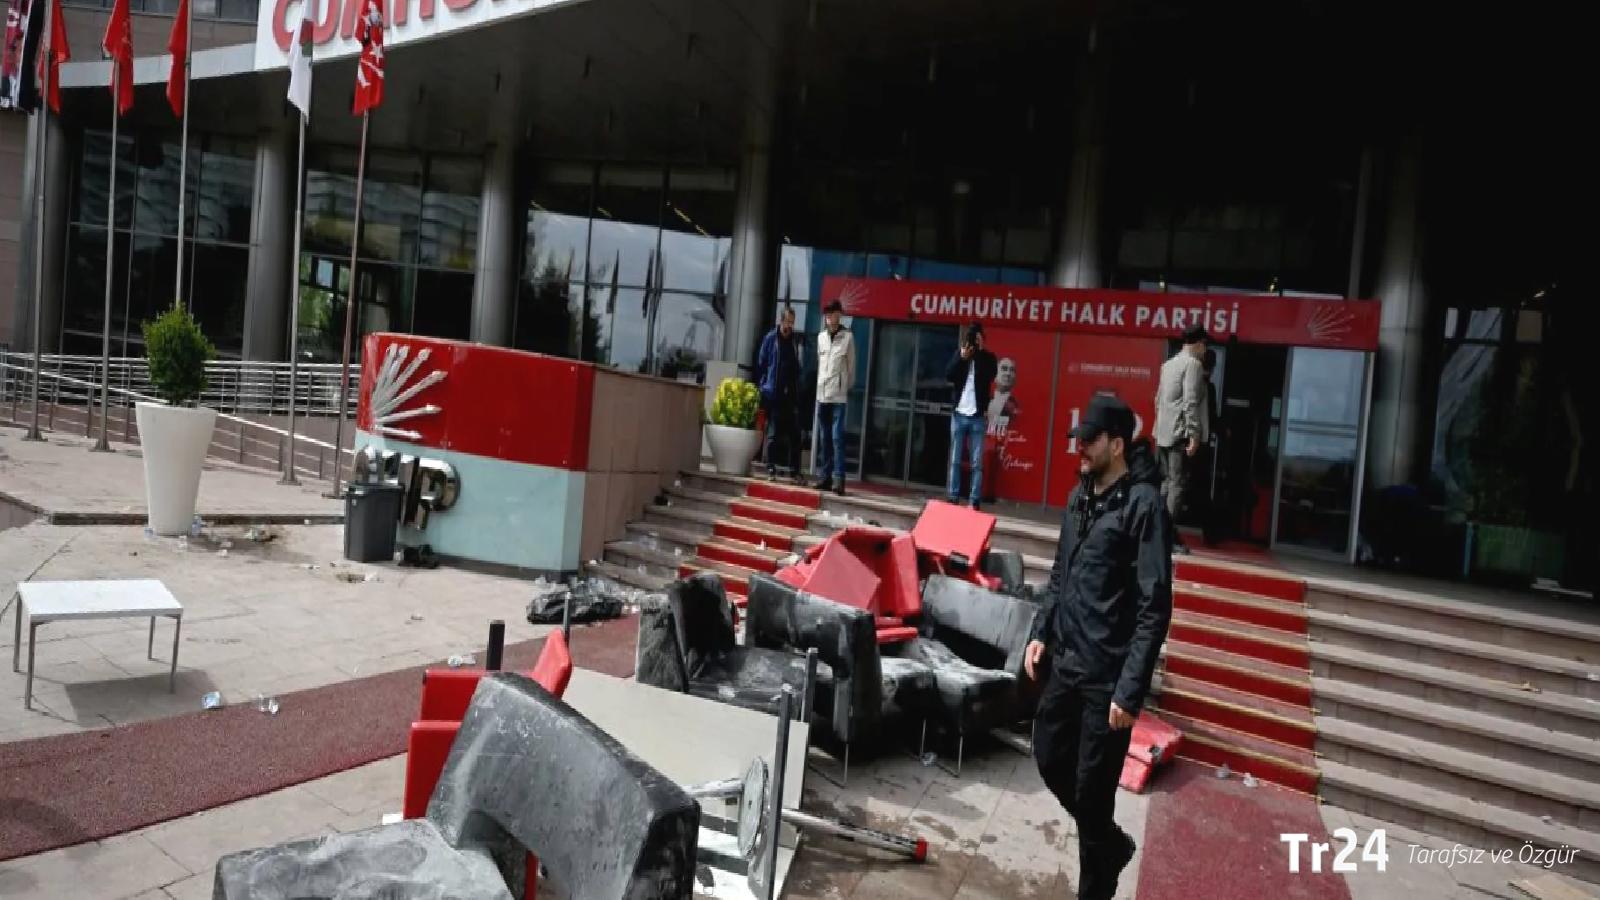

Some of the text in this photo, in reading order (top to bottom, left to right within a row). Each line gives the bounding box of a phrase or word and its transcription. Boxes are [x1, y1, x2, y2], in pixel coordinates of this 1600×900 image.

[911, 292, 1239, 334] CUMHURİYET HALK PARTİSİ
